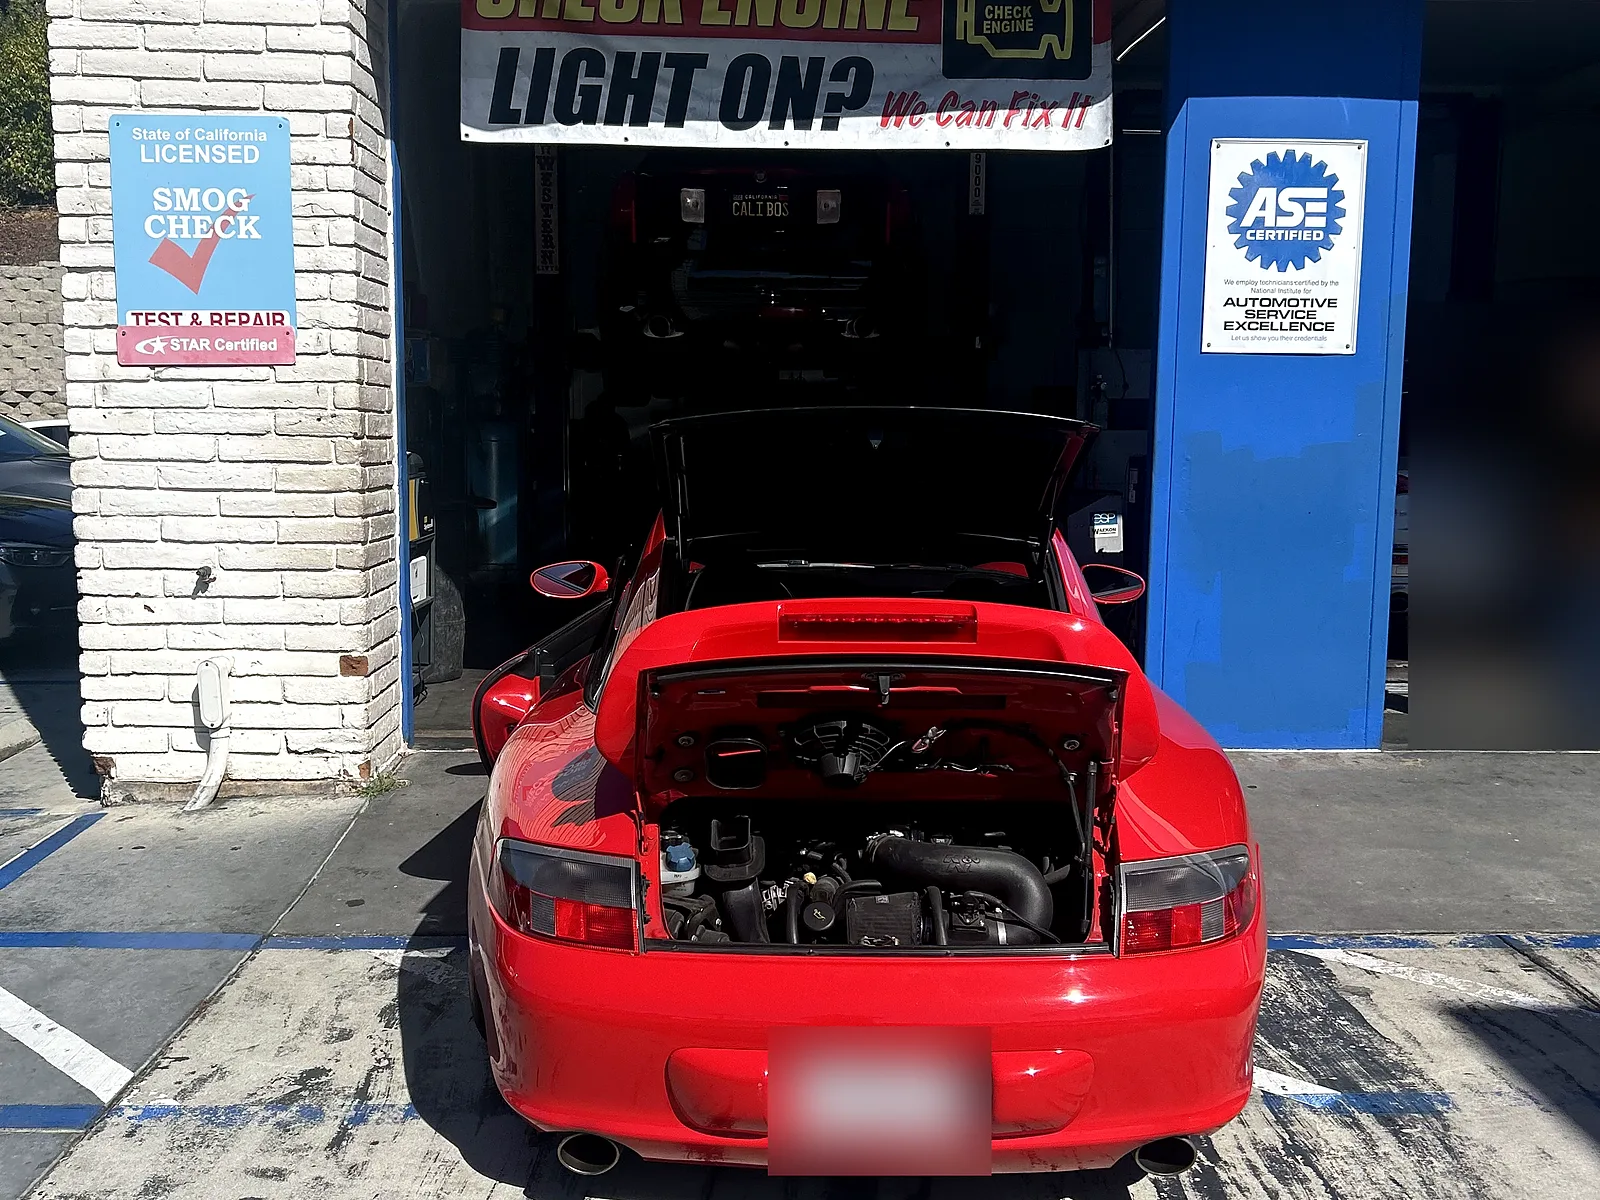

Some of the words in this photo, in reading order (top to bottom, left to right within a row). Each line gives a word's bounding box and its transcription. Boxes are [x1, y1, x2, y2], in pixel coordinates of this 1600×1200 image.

[984, 4, 1032, 20] CHECK
[983, 19, 1034, 34] ENGINE
[488, 47, 709, 128] LIGHT
[718, 53, 875, 131] ON?
[879, 90, 927, 129] We
[935, 90, 997, 129] Can
[1002, 91, 1059, 130] Fix
[1061, 92, 1093, 130] It
[132, 128, 171, 141] State
[174, 128, 190, 141] of
[194, 128, 267, 142] California
[140, 144, 260, 164] LICENSED
[152, 187, 251, 212] SMOG
[1239, 187, 1328, 228] ASE
[144, 215, 262, 239] CHECK
[1245, 229, 1324, 241] CERTIFIED
[1320, 279, 1329, 287] by
[1330, 279, 1339, 287] the
[1223, 297, 1338, 308] AUTOMOTIVE
[131, 312, 183, 326] TEST
[210, 312, 285, 326] REPAIR
[1244, 309, 1317, 319] SERVICE
[1224, 321, 1335, 332] EXCELLENCE
[170, 338, 211, 351] STAR
[214, 338, 278, 351] Certified
